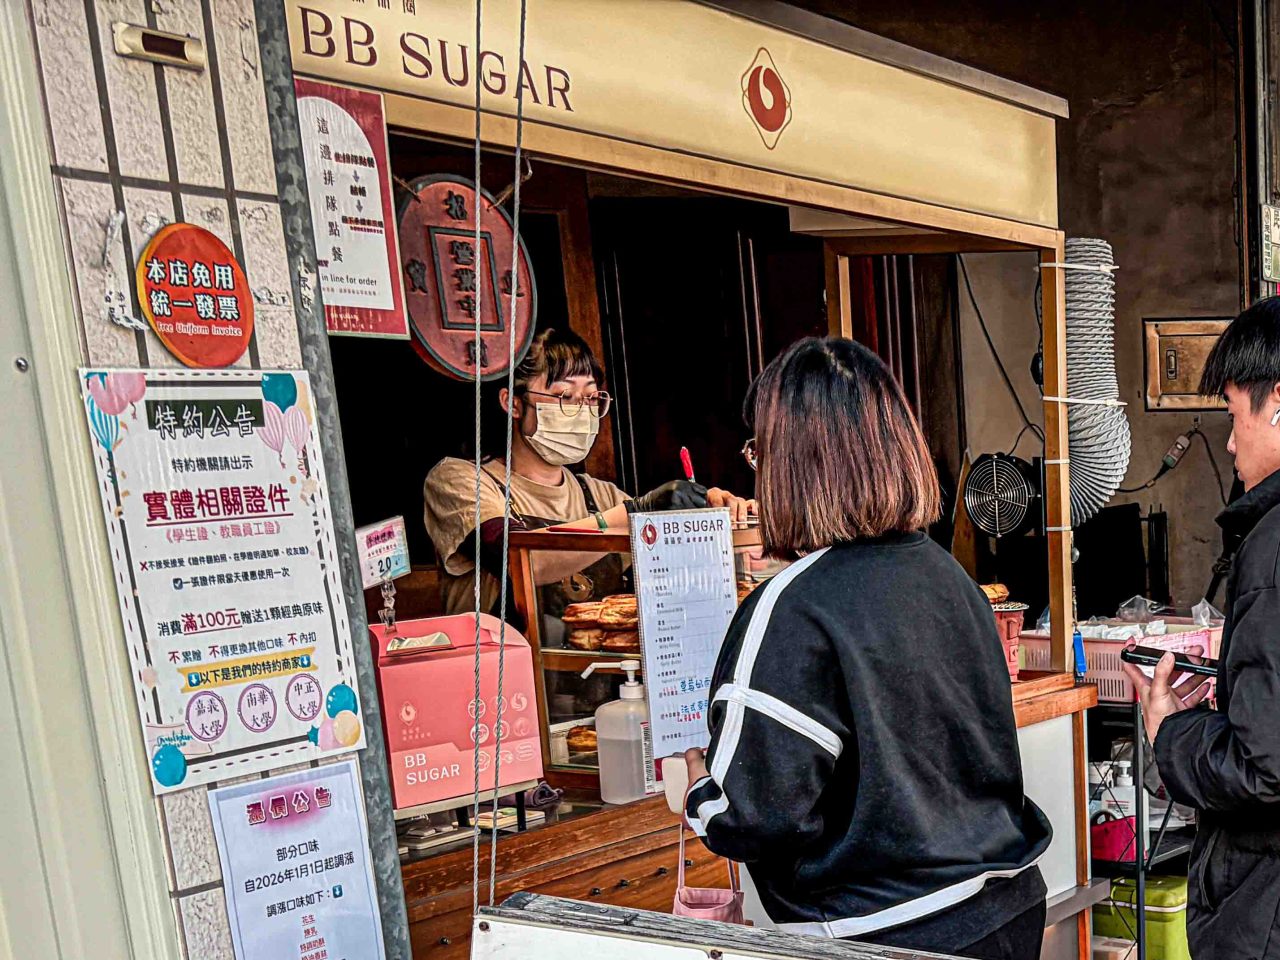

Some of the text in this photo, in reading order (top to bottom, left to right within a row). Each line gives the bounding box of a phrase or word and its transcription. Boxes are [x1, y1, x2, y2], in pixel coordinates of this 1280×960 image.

[297, 6, 574, 112] BB SUGAR
[146, 257, 235, 290] 本店免用
[330, 272, 344, 284] line
[346, 274, 357, 284] for
[358, 276, 377, 286] order
[149, 290, 241, 322] 統一發票
[156, 321, 242, 336] Free Uniform Invoice
[155, 404, 256, 440] 特約公告
[143, 484, 290, 522] 實體相關證件
[663, 519, 724, 535] BB SUGAR
[200, 656, 300, 685] 以下是我們的特約商家
[246, 690, 270, 708] 南華
[294, 681, 315, 697] 中正
[195, 698, 220, 716] 嘉義
[298, 700, 318, 717] 大學
[199, 719, 222, 737] 大學
[251, 712, 272, 728] 大學
[404, 753, 427, 768] BB
[406, 763, 460, 785] SUGAR
[246, 786, 332, 825] 漲價公告
[276, 839, 320, 862] 部分口味
[245, 851, 355, 893] 自2026年1月1日起調漲
